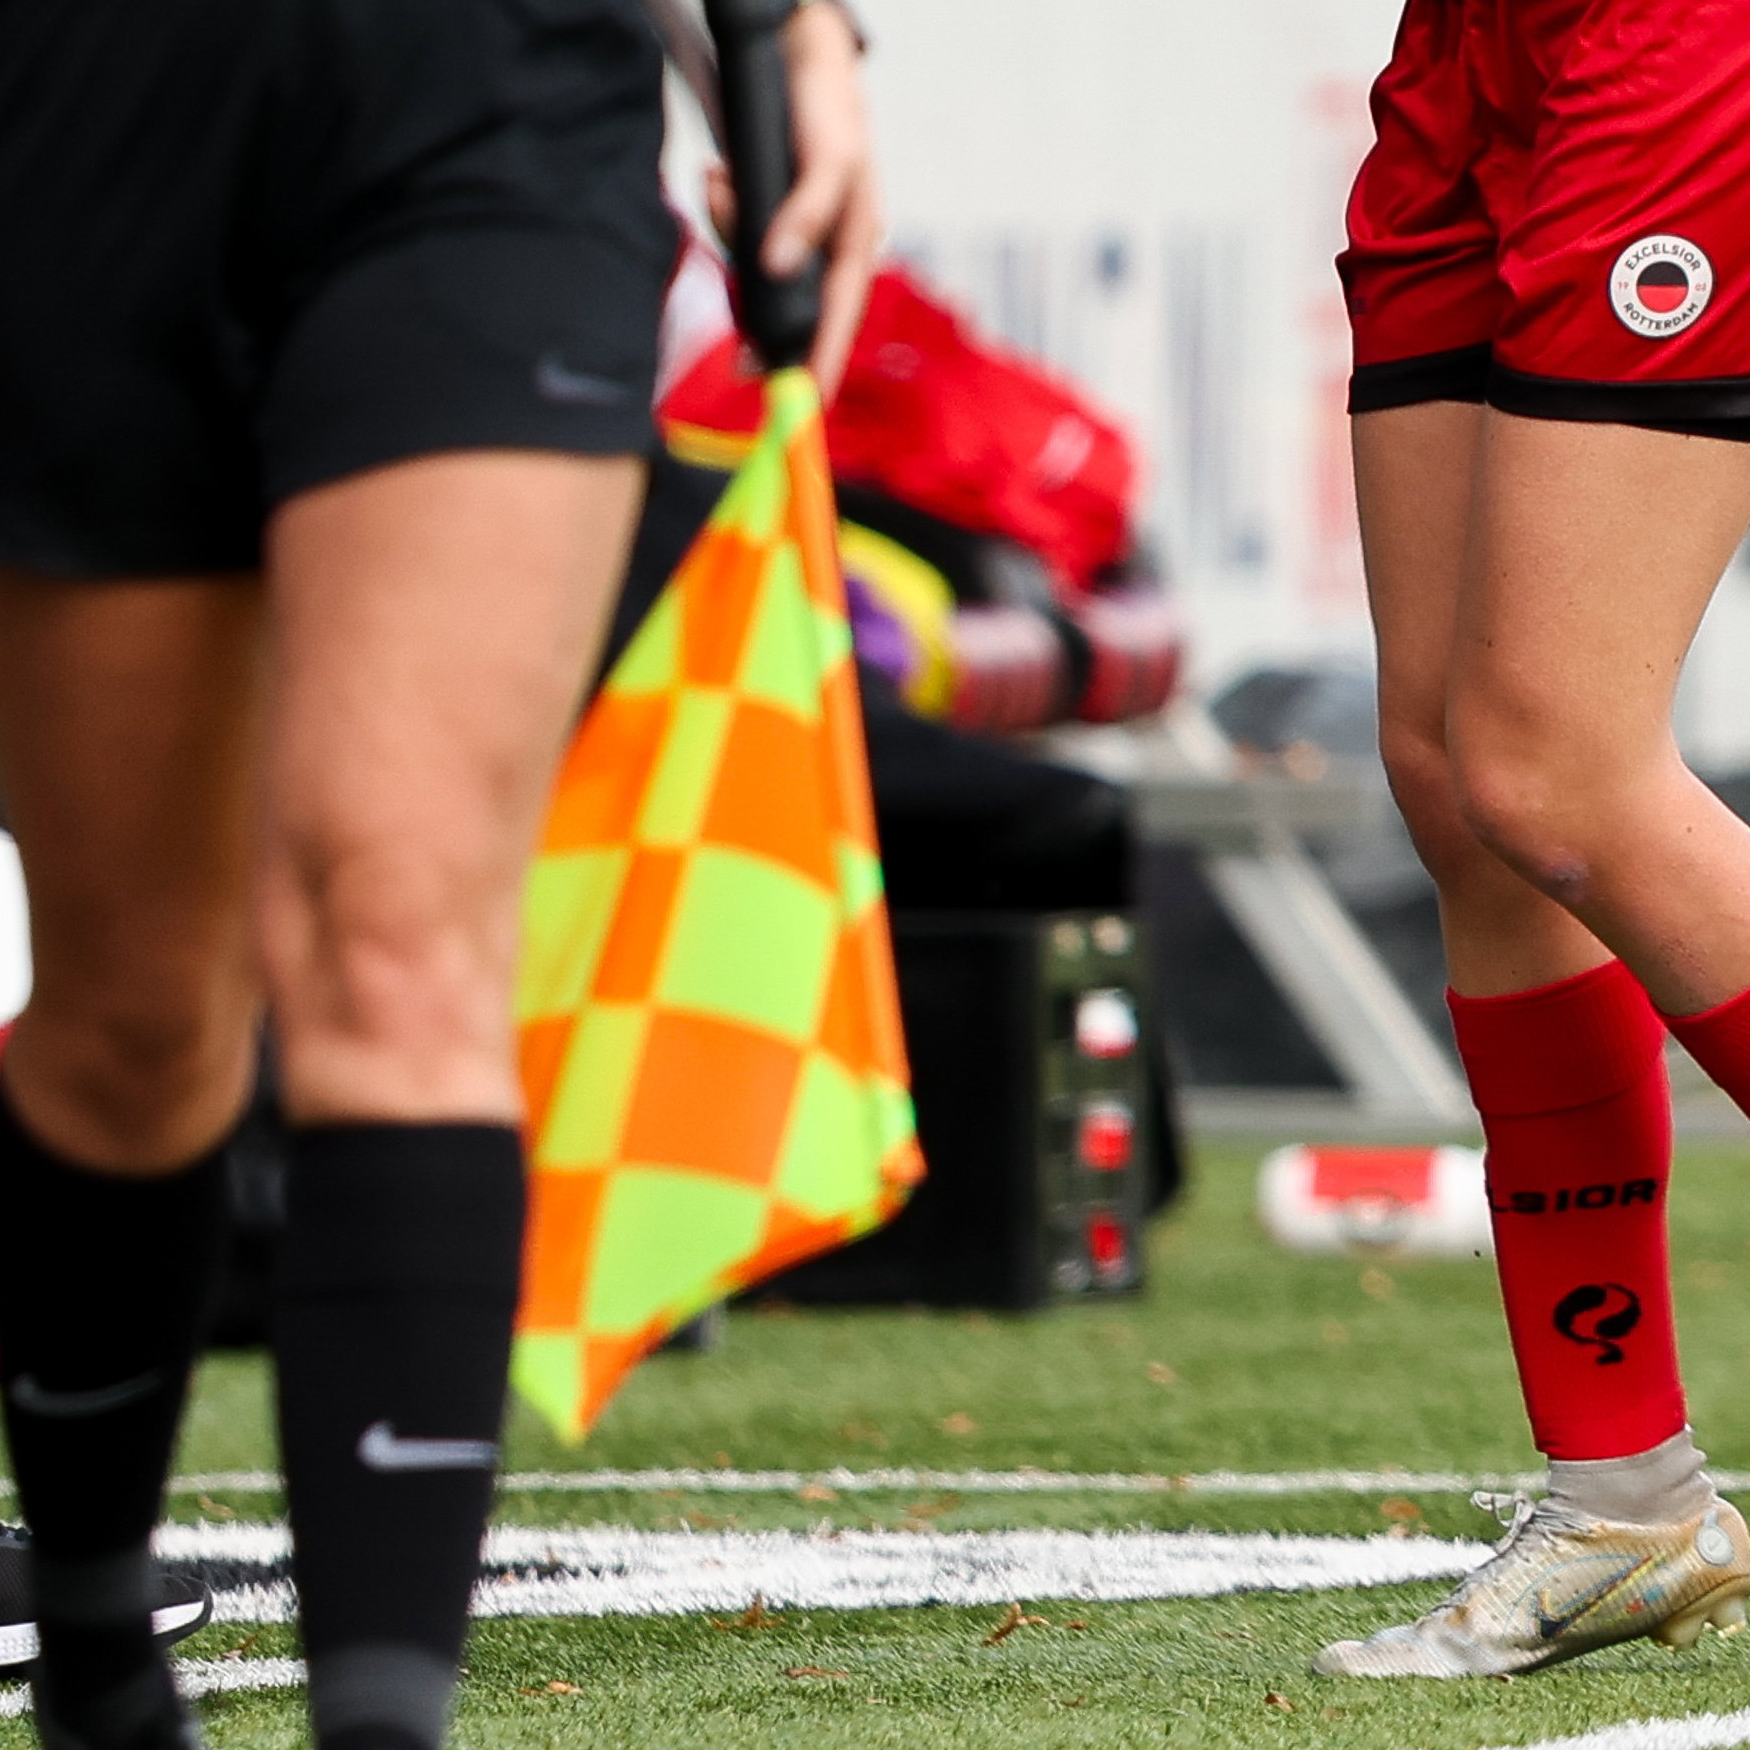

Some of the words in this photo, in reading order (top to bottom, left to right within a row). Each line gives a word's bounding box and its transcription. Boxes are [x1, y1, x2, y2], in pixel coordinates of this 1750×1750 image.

[1625, 243, 1701, 271] EXCELSIOR
[1617, 281, 1629, 290] 19
[1624, 302, 1698, 330] ROTTERDAM
